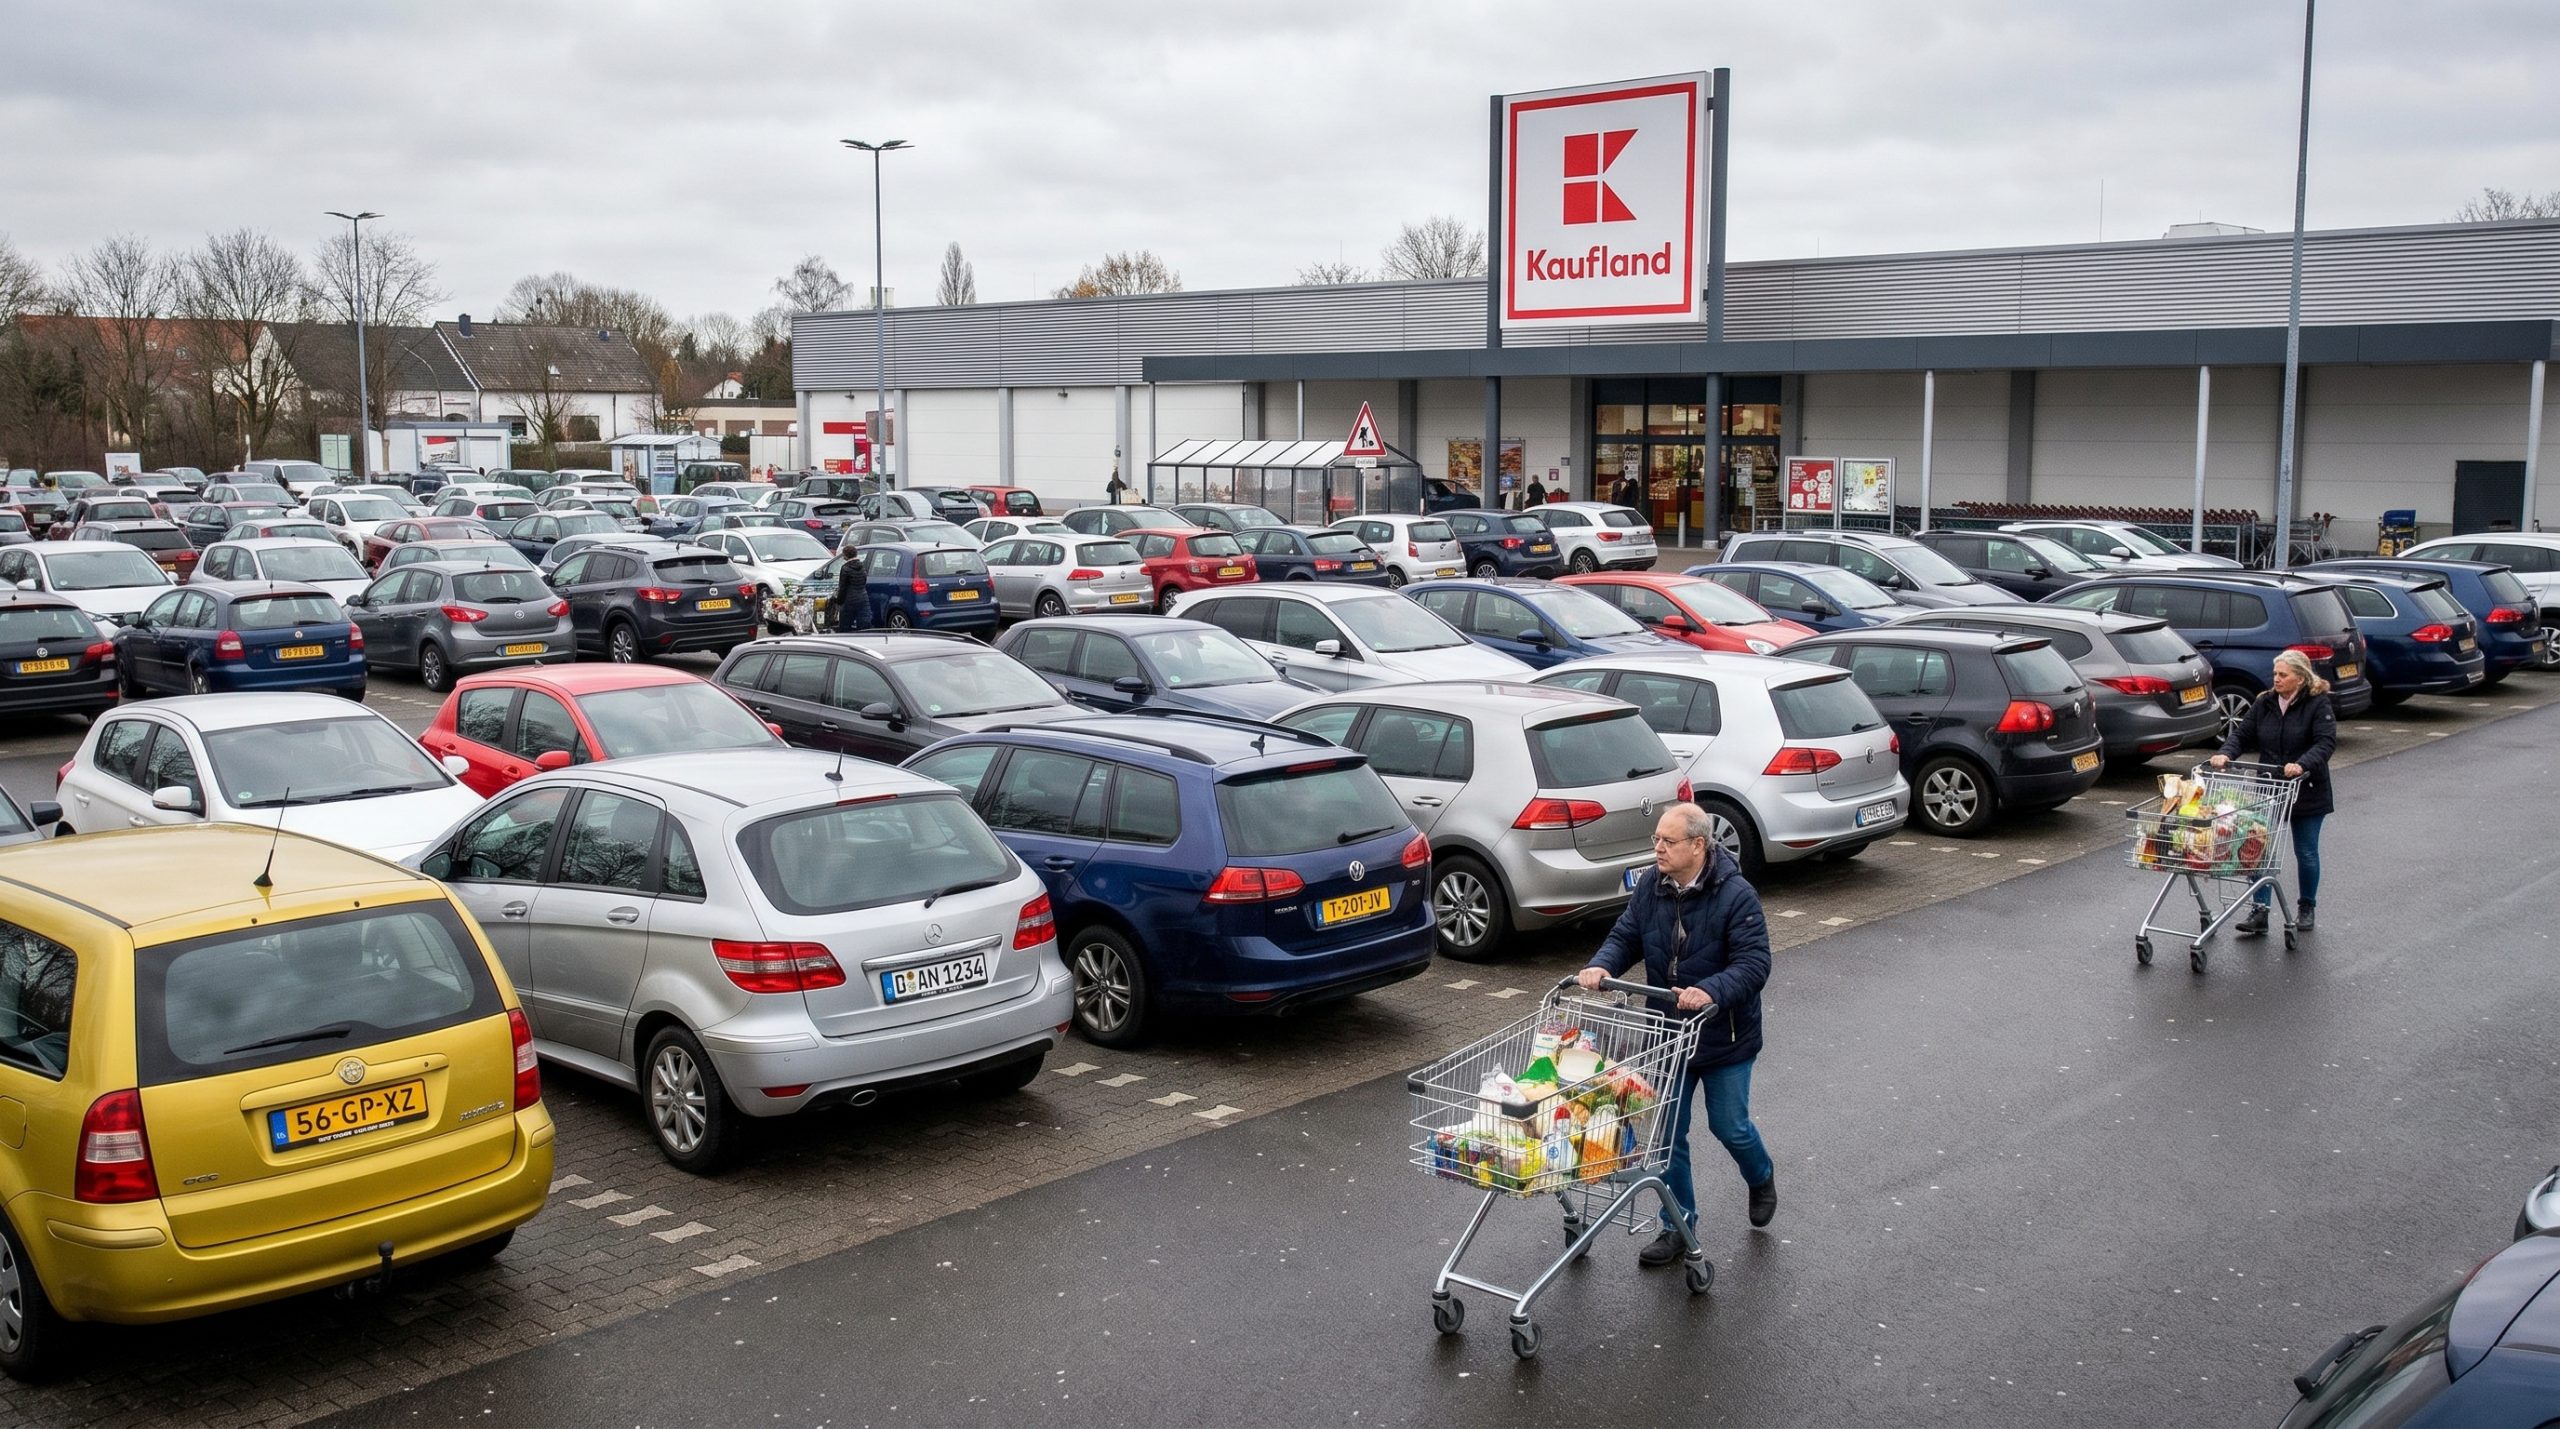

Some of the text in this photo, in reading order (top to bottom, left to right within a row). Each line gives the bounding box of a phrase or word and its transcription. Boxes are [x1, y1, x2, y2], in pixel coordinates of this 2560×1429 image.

[1527, 242, 1671, 281] Kaufland
[918, 967, 940, 990] AN
[943, 958, 984, 985] 1234
[296, 1087, 416, 1136] 56-GP-XZ
